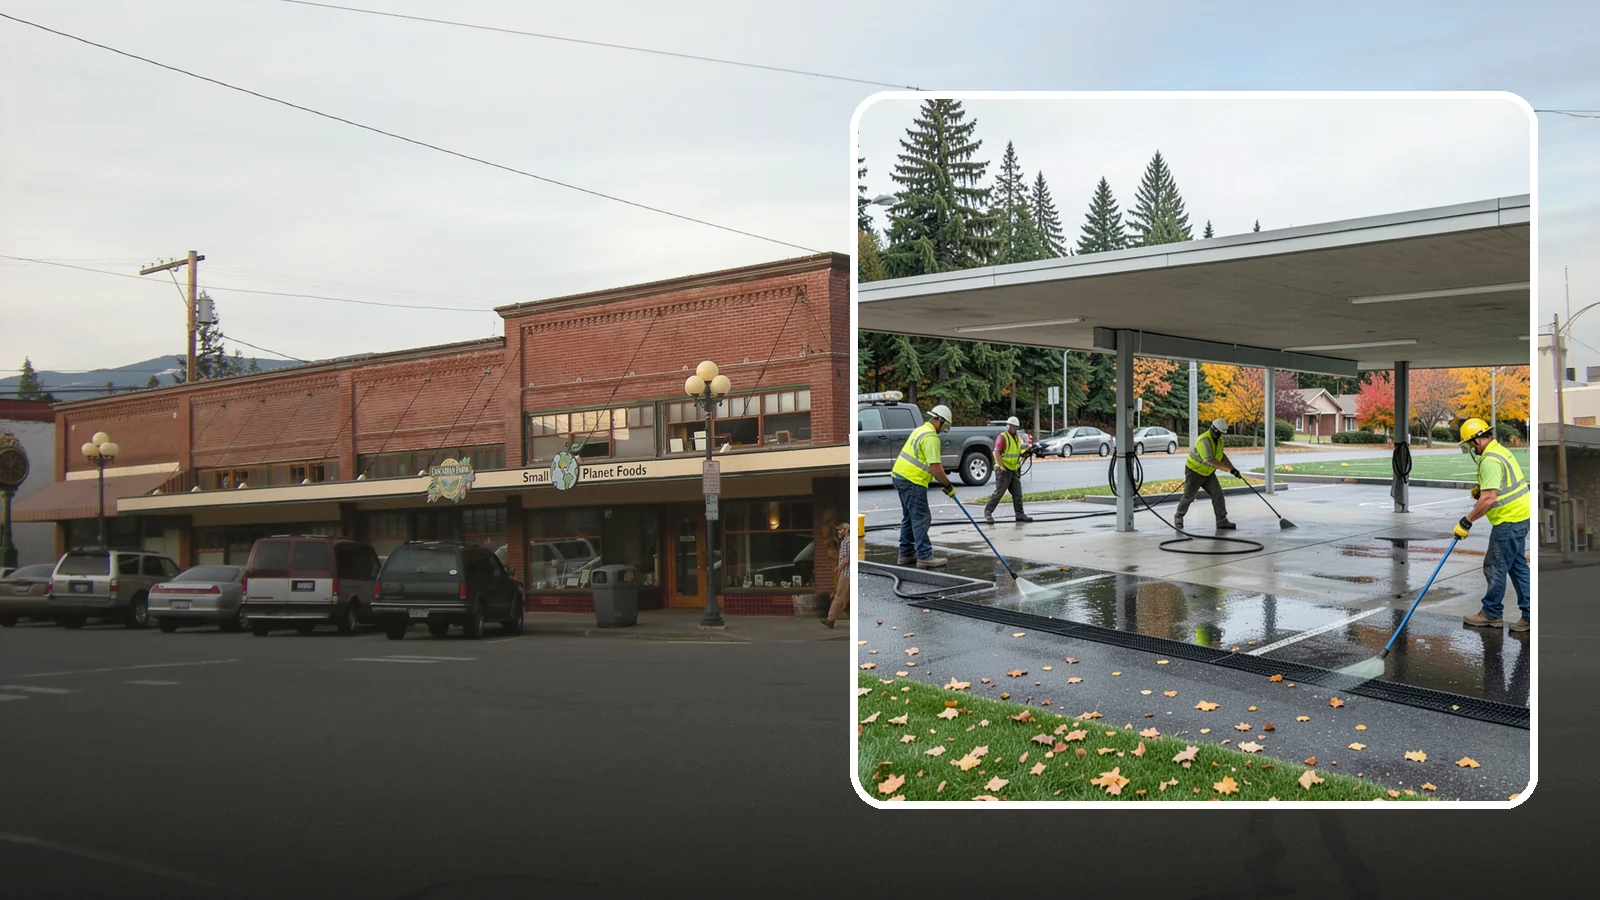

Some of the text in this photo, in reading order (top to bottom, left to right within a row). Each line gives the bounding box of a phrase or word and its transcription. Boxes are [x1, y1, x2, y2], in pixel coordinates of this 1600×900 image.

[523, 464, 647, 483] Small Planet Foods
